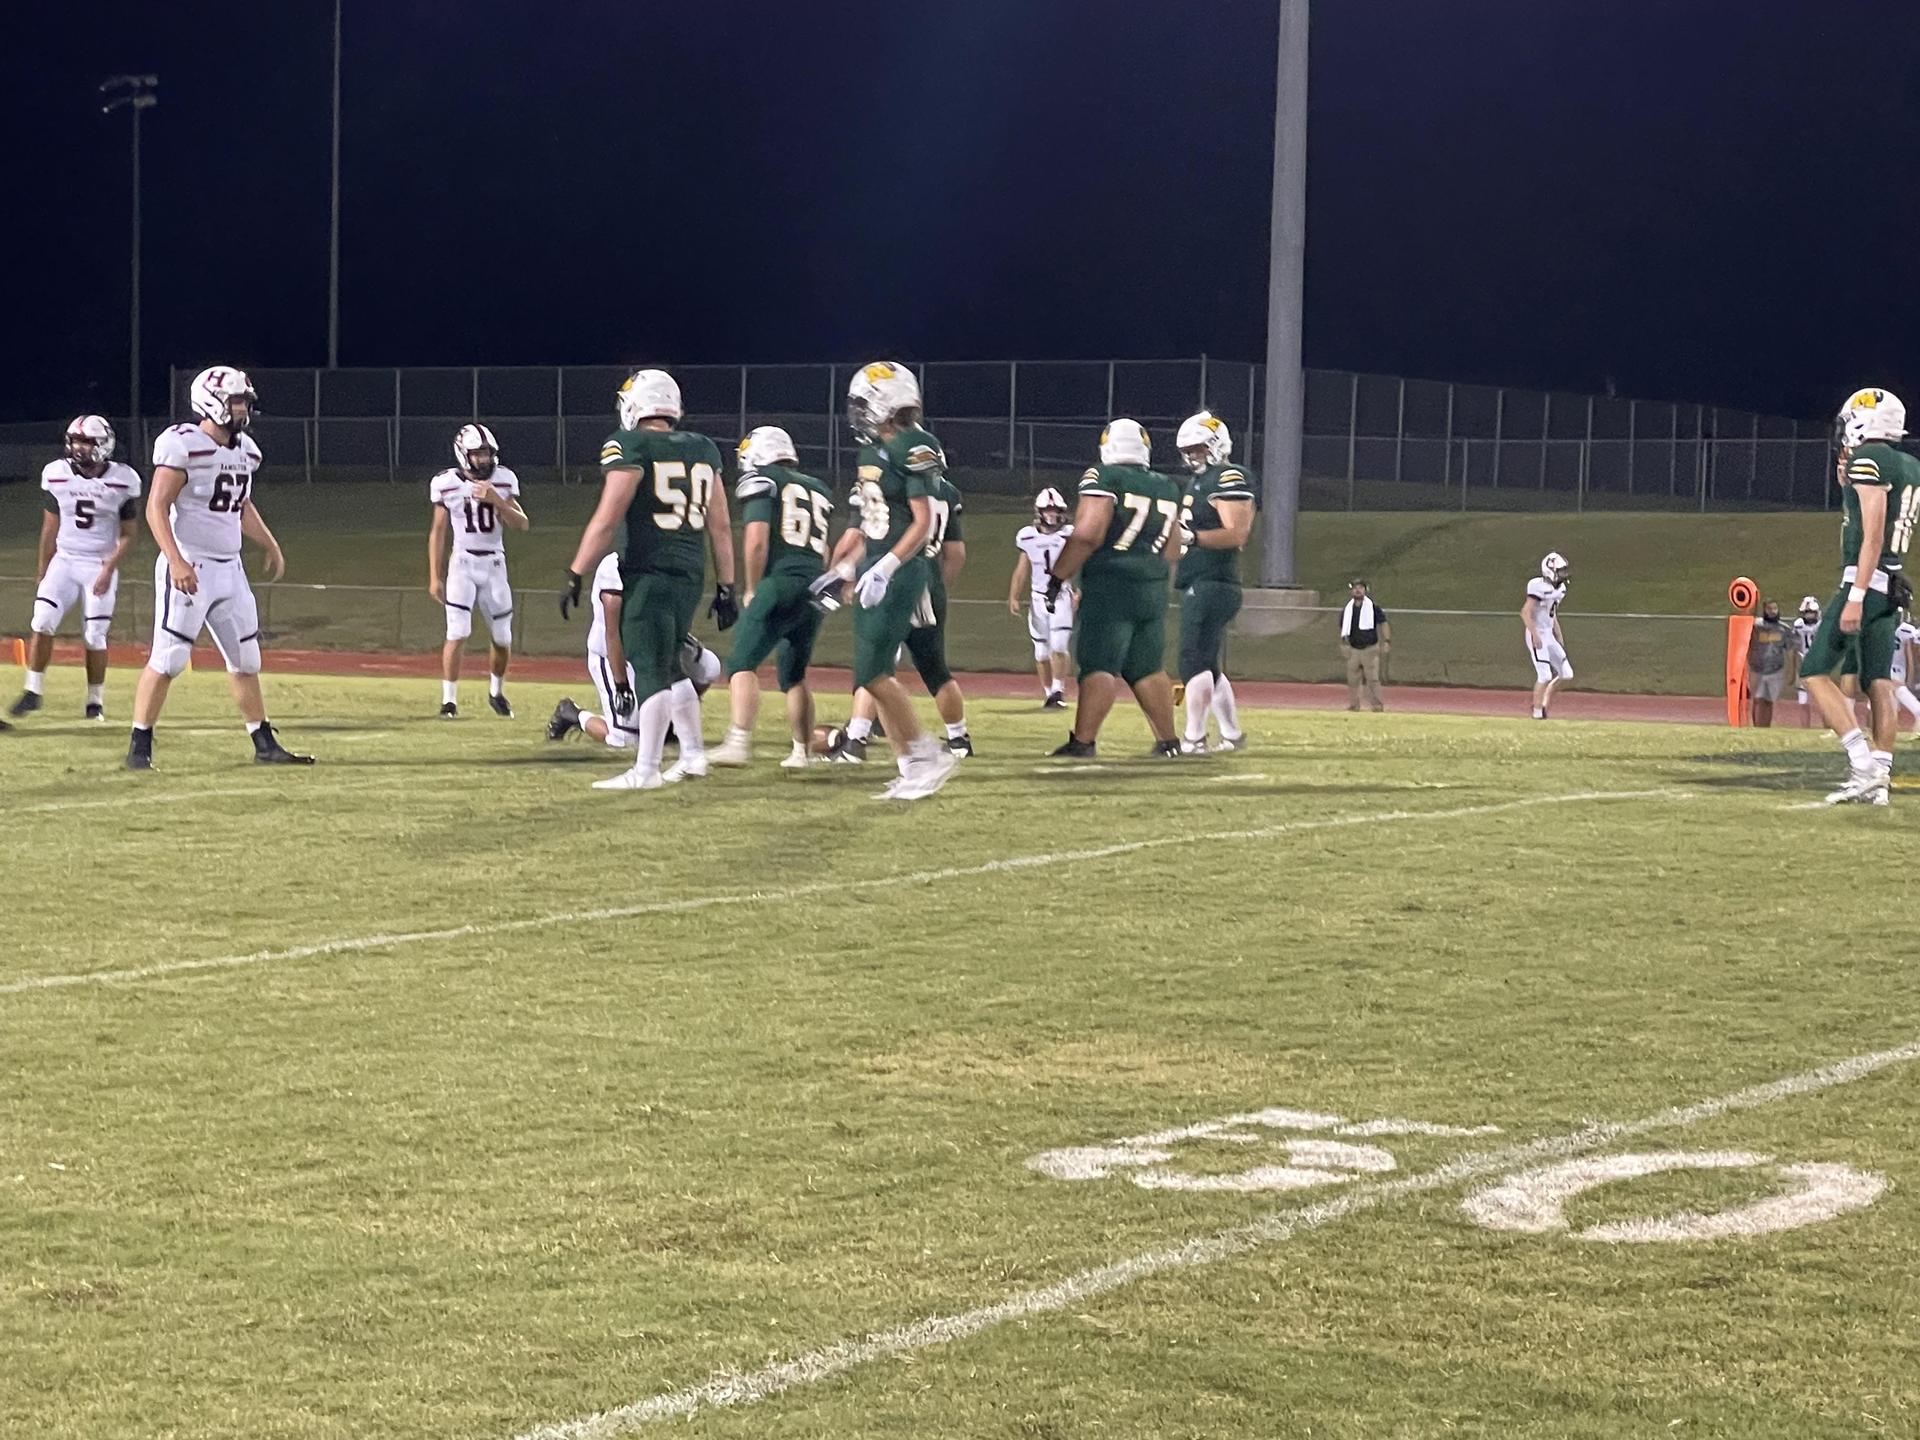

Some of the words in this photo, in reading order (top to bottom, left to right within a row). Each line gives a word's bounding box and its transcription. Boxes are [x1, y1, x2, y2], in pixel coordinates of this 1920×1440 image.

[204, 371, 230, 388] H
[209, 473, 249, 512] 67
[652, 460, 714, 531] 50
[75, 499, 96, 529] 5
[464, 499, 495, 533] 10
[781, 483, 835, 556] 65
[1113, 492, 1178, 554] 77
